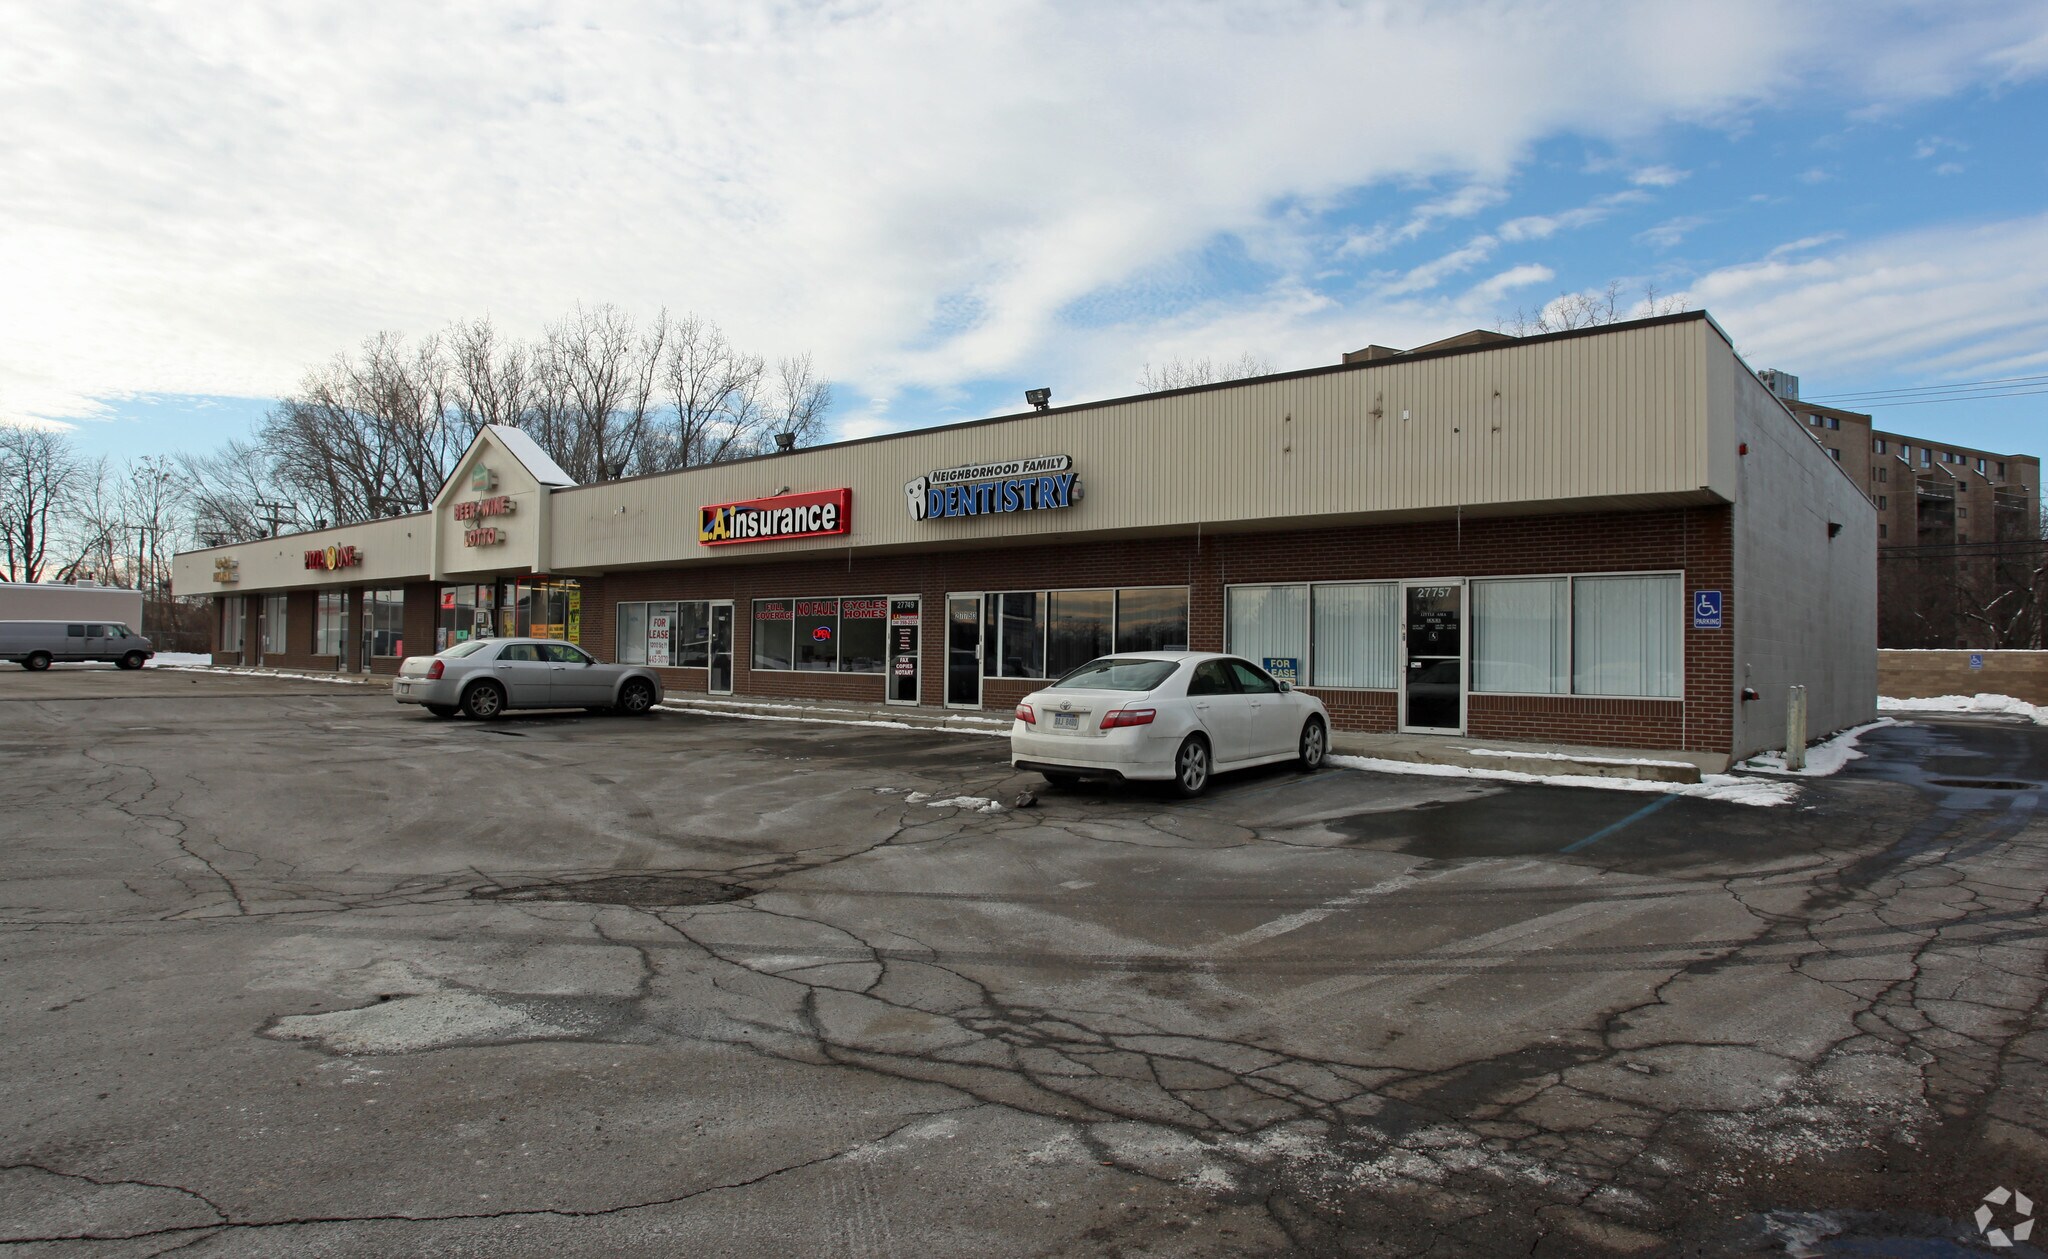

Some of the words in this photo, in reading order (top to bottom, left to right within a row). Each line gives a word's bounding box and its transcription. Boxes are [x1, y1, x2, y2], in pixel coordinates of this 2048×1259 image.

[931, 464, 1019, 483] NEIGHBORHOOD
[1022, 457, 1065, 473] FAMILY
[927, 473, 1075, 519] DENTISTRY
[454, 501, 476, 521] BEER
[482, 496, 508, 517] WINE
[730, 503, 836, 539] insurance
[464, 528, 496, 547] LOTTO
[304, 550, 326, 570] PIZZA
[336, 546, 355, 567] ONE
[1417, 588, 1452, 598] 27757
[765, 603, 784, 611] FULL
[797, 602, 810, 616] NO
[812, 601, 839, 616] FAULT
[842, 600, 888, 610] CYCLES
[755, 611, 794, 620] COVERAGE
[844, 609, 887, 619] HOMES
[653, 618, 667, 627] FOR
[649, 630, 669, 639] LEASE
[813, 629, 831, 639] OPEN
[1270, 659, 1290, 668] FOR
